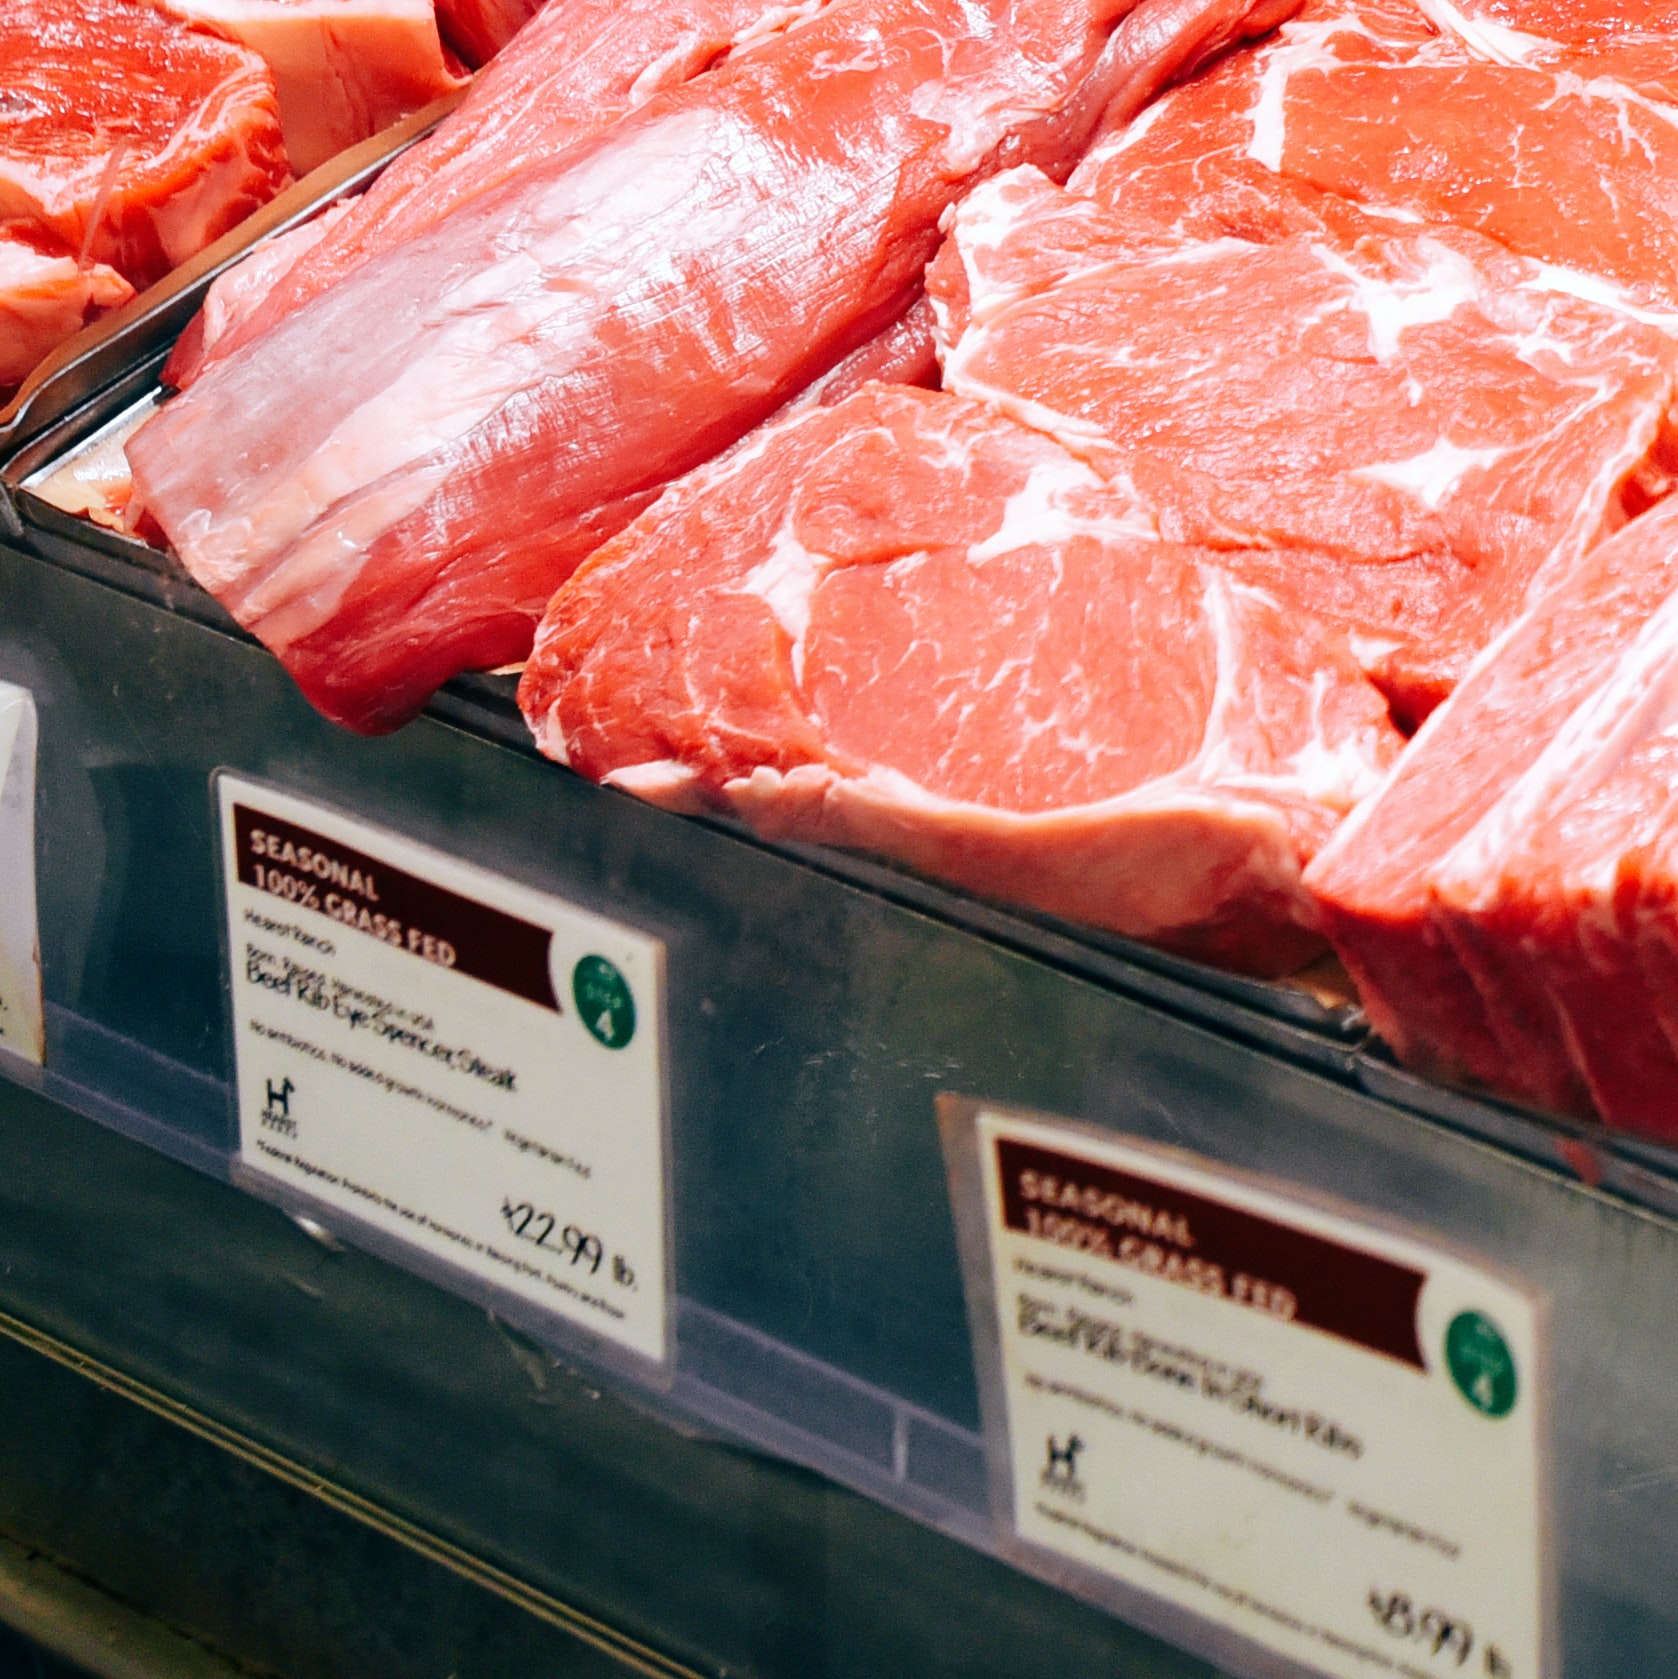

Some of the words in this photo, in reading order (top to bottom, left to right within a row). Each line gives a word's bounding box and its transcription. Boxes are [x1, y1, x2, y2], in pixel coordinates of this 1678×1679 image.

[250, 828, 380, 902] SEASONAL
[253, 864, 321, 912] 100%
[324, 892, 403, 948] GRASS
[406, 927, 457, 969] FED
[246, 959, 297, 997] Beef
[1018, 1169, 1197, 1249] SEASONAL
